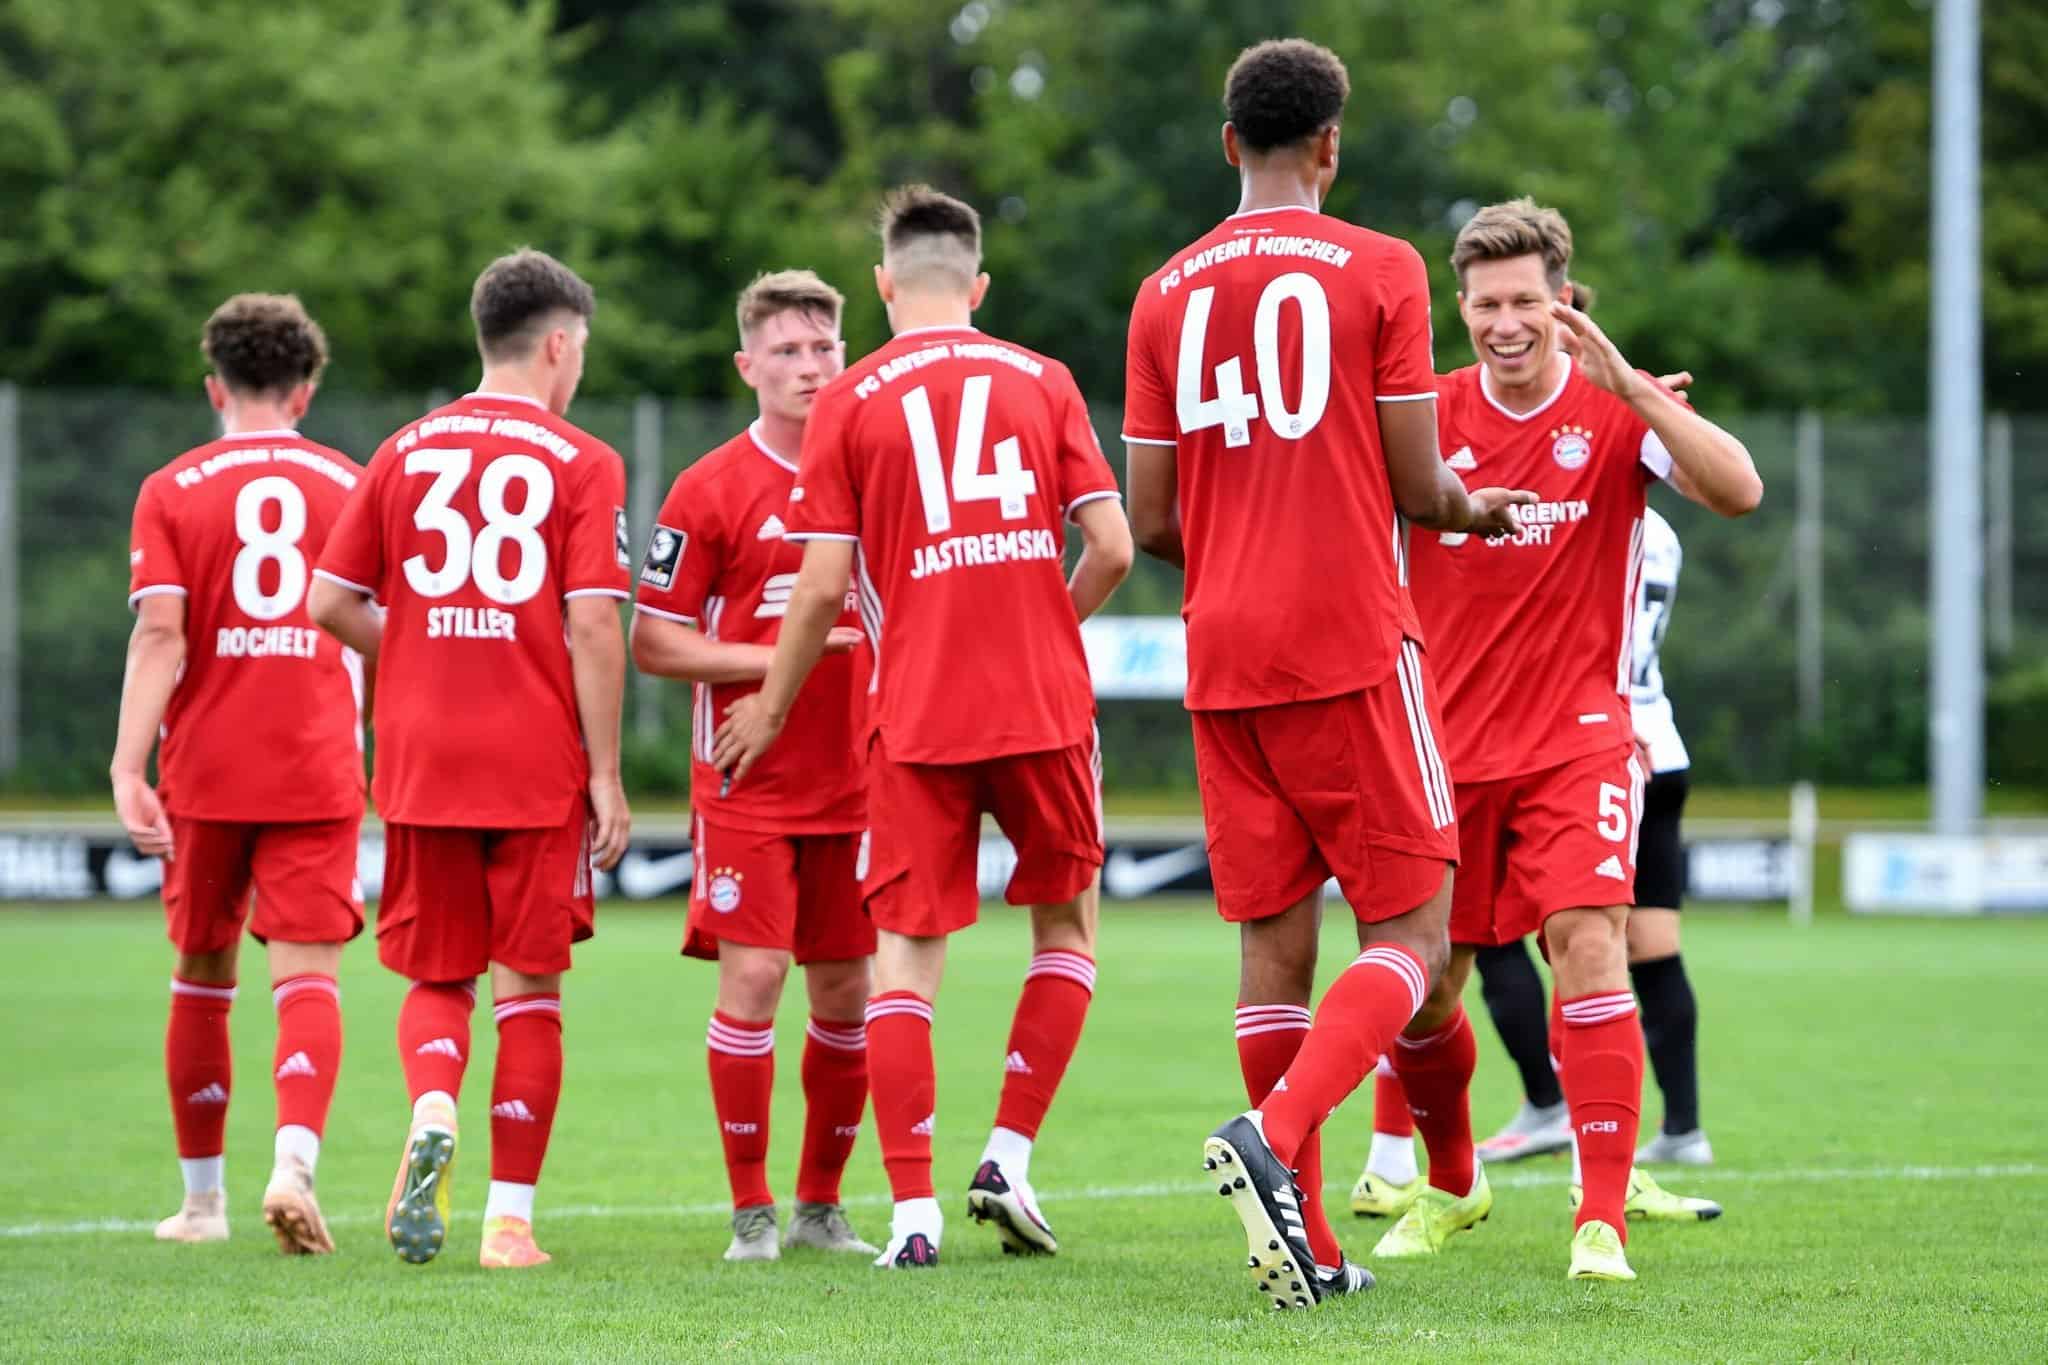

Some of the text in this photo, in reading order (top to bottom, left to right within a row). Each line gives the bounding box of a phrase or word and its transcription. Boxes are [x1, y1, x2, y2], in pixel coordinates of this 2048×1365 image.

[1160, 270, 1181, 295] FC
[1183, 236, 1252, 279] BAYERN
[854, 375, 881, 399] FC
[1176, 272, 1332, 448] 40
[901, 375, 1036, 534] 14
[402, 448, 555, 605] 38
[1507, 500, 1589, 523] AGENTA
[232, 476, 307, 621] 8
[910, 529, 1058, 580] JASTREMSKI
[216, 627, 320, 658] ROCHELT
[426, 606, 517, 642] STILLER
[1596, 781, 1628, 843] 5
[1581, 1120, 1619, 1136] FCB
